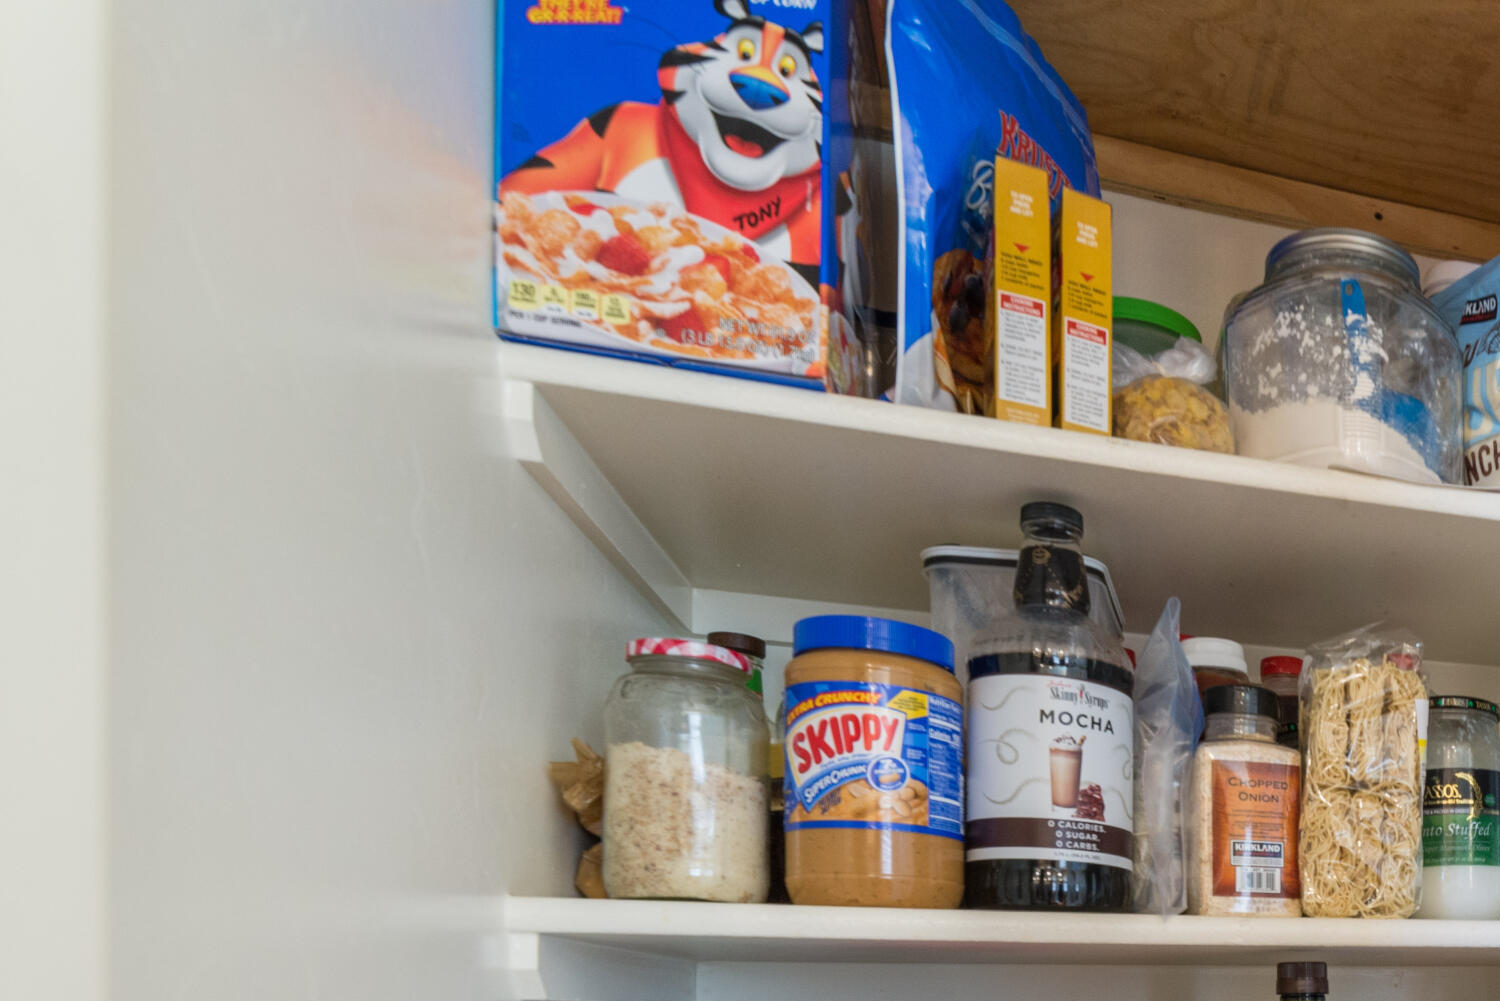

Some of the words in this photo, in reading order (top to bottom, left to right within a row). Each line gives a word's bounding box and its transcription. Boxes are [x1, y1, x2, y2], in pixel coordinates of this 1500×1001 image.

[732, 195, 782, 231] TONY
[815, 690, 883, 708] CRUNCHY
[1050, 686, 1078, 704] Skinny
[1084, 691, 1110, 711] Syrups
[1039, 709, 1114, 735] MOCHA
[792, 713, 900, 774] SKIPPY
[1227, 776, 1289, 790] CHOPPED
[1238, 791, 1280, 802] ONION
[1448, 821, 1492, 840] Stuffed
[1235, 842, 1280, 853] KIRKLAND
